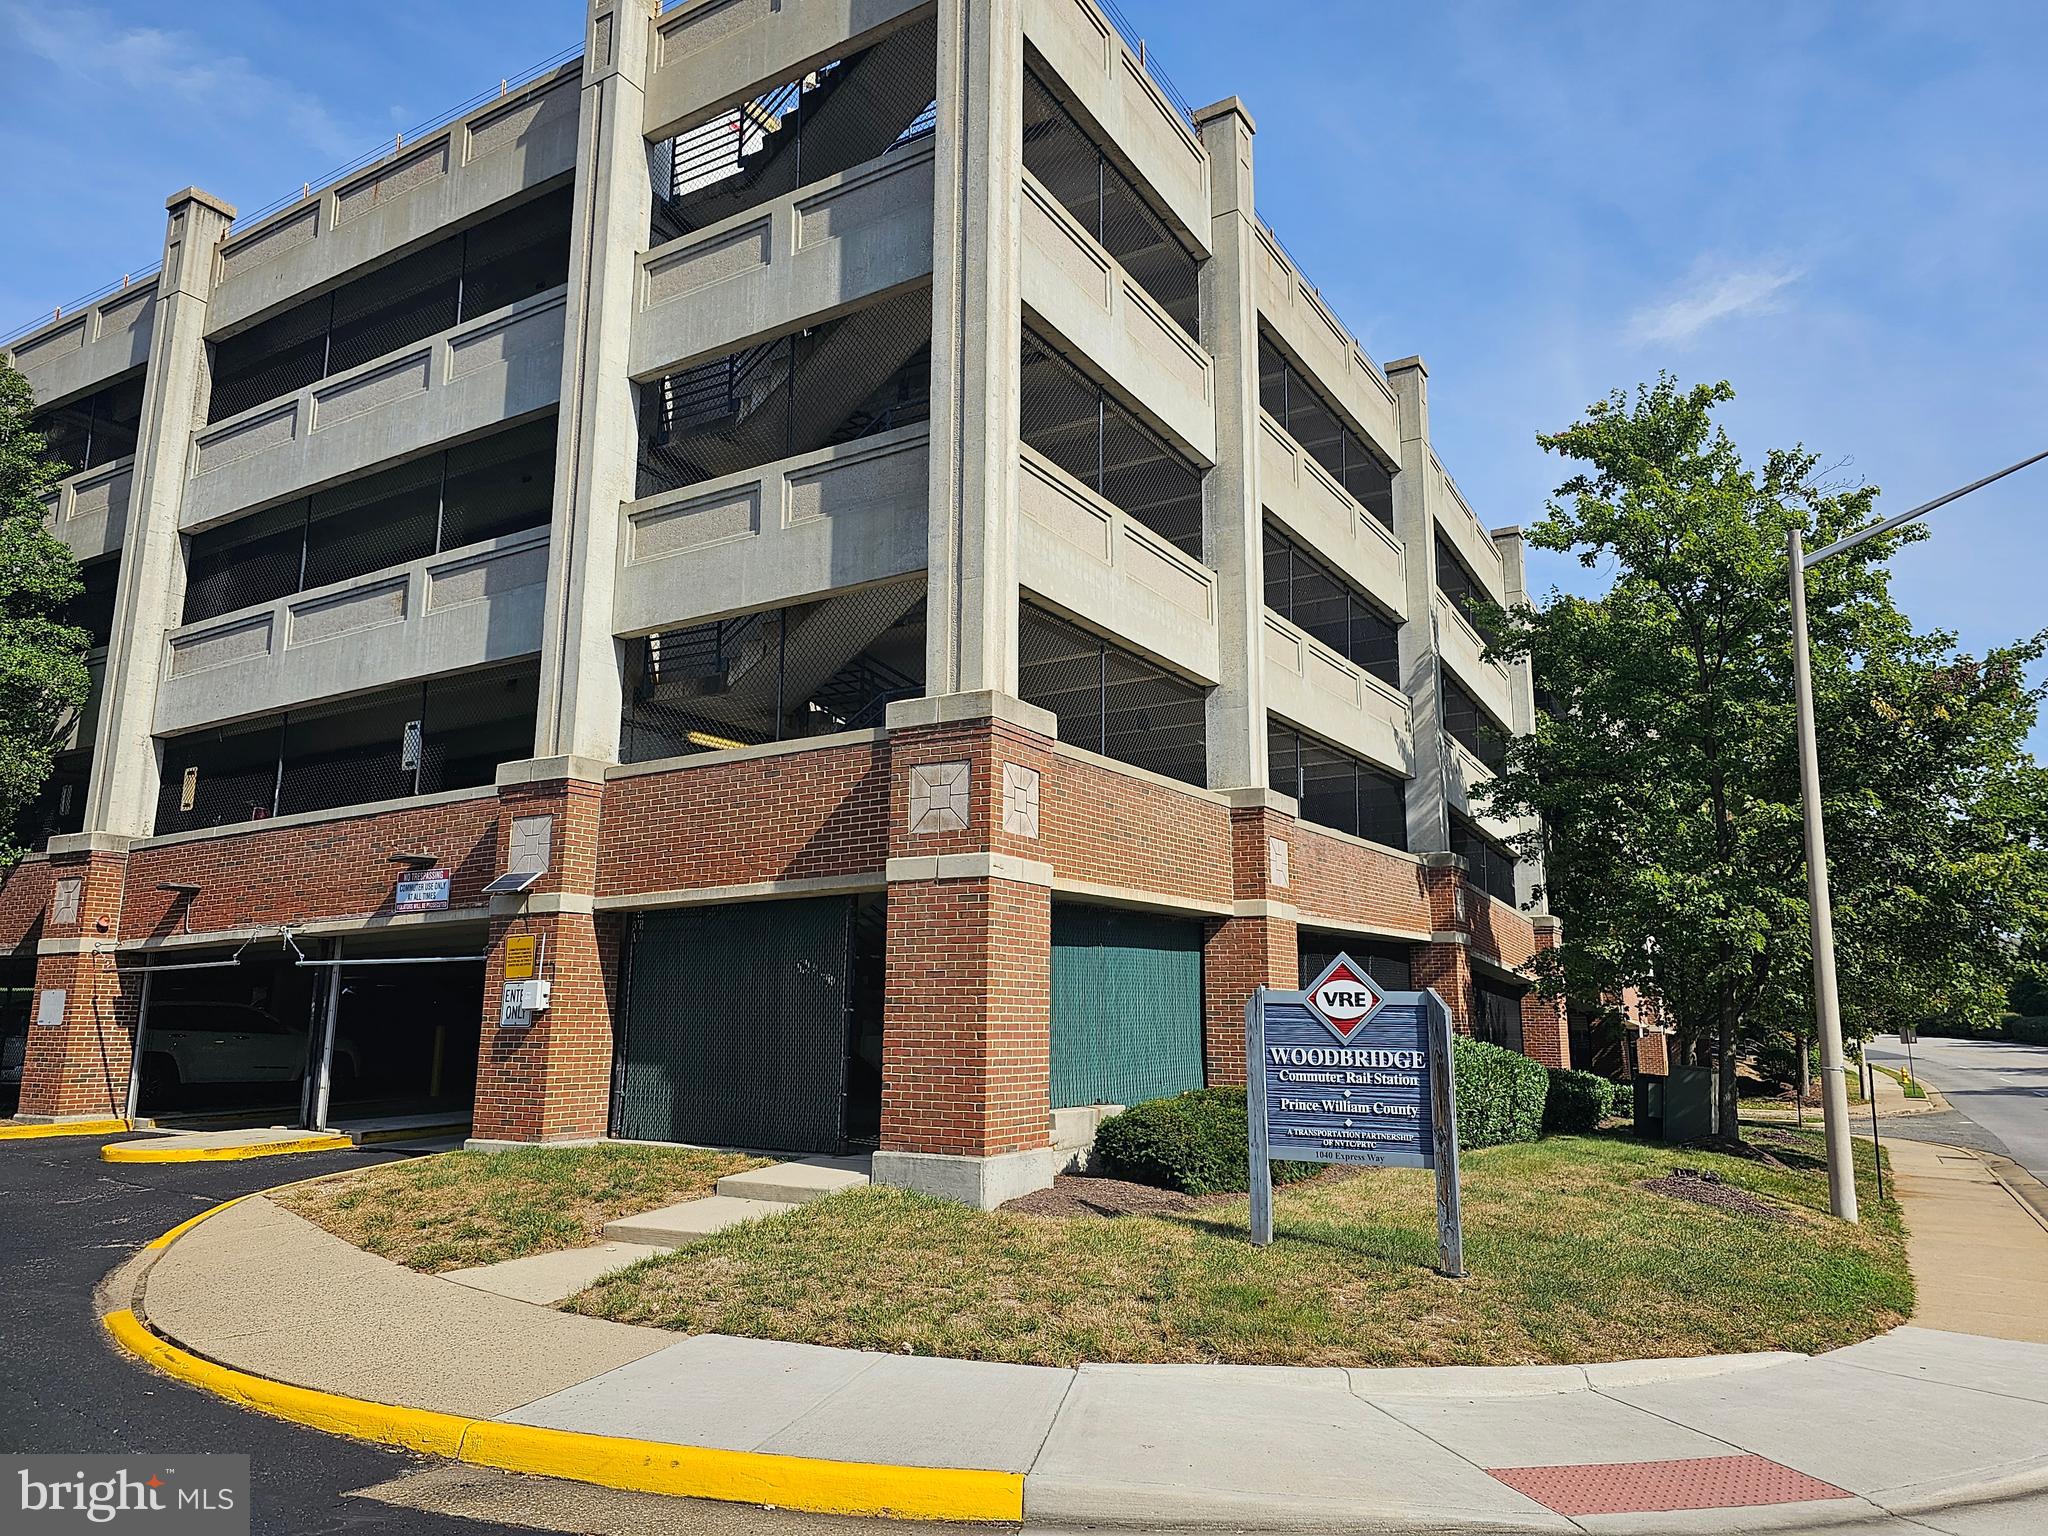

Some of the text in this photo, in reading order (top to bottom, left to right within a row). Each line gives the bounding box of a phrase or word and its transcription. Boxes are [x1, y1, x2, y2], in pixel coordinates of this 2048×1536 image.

[403, 870, 444, 881] NO TRESPASSING
[400, 881, 447, 892] COMMUTER USE ONLY
[413, 892, 422, 900] ALL
[422, 891, 437, 900] TIMES
[505, 989, 523, 1003] ENTE
[1322, 991, 1366, 1007] VRE
[1270, 1047, 1426, 1069] WOODBRIDGE
[1279, 1069, 1420, 1087] Commuter Rail Station
[1280, 1098, 1418, 1118] Prince William County
[1294, 1129, 1361, 1139] TRANSPORTATION
[1361, 1132, 1414, 1141] PARTNERSHIP
[1315, 1151, 1385, 1164] 1040 Express Way
